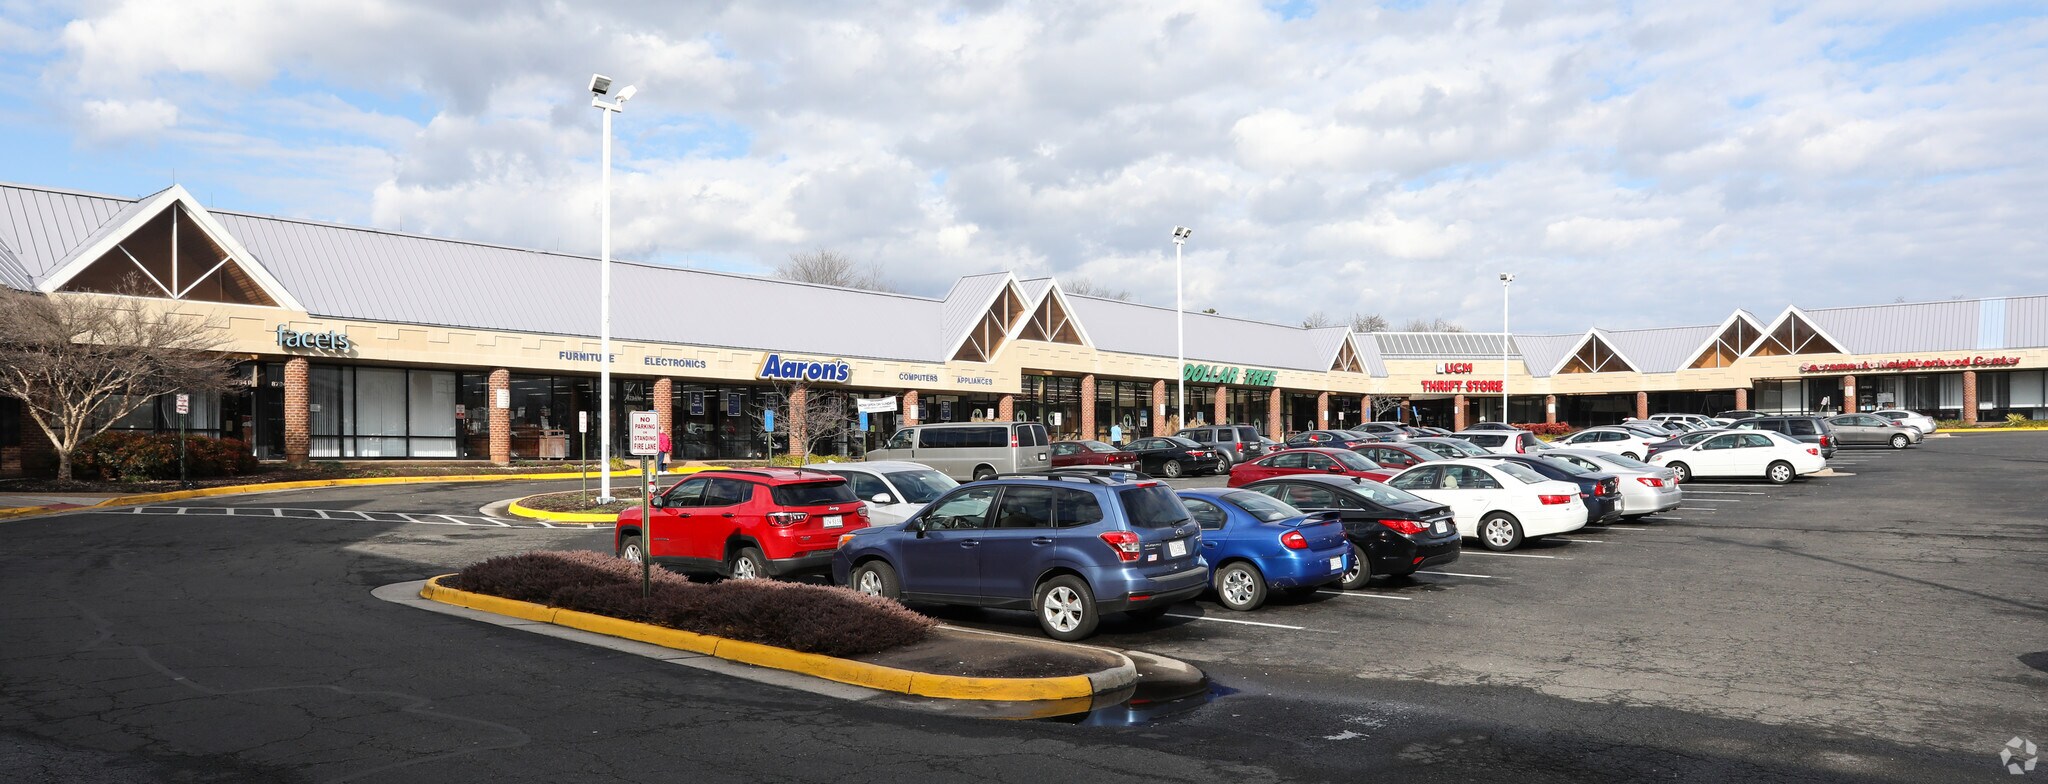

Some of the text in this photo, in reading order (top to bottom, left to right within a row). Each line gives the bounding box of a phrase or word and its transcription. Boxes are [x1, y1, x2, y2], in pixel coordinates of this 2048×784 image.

[276, 323, 350, 350] facets
[559, 351, 615, 363] FURNITUE
[644, 356, 706, 369] ELECTRONICS
[1801, 355, 2021, 371] Sacramento Neighborhood Center
[761, 354, 849, 381] Aaron's
[1445, 362, 1473, 374] UCM
[899, 373, 938, 383] COMPUTERS
[957, 376, 993, 386] APPLIANCES
[1183, 363, 1278, 387] DOLLAR TREE
[1421, 380, 1504, 392] THRIFT STORE
[644, 443, 657, 451] LANE
